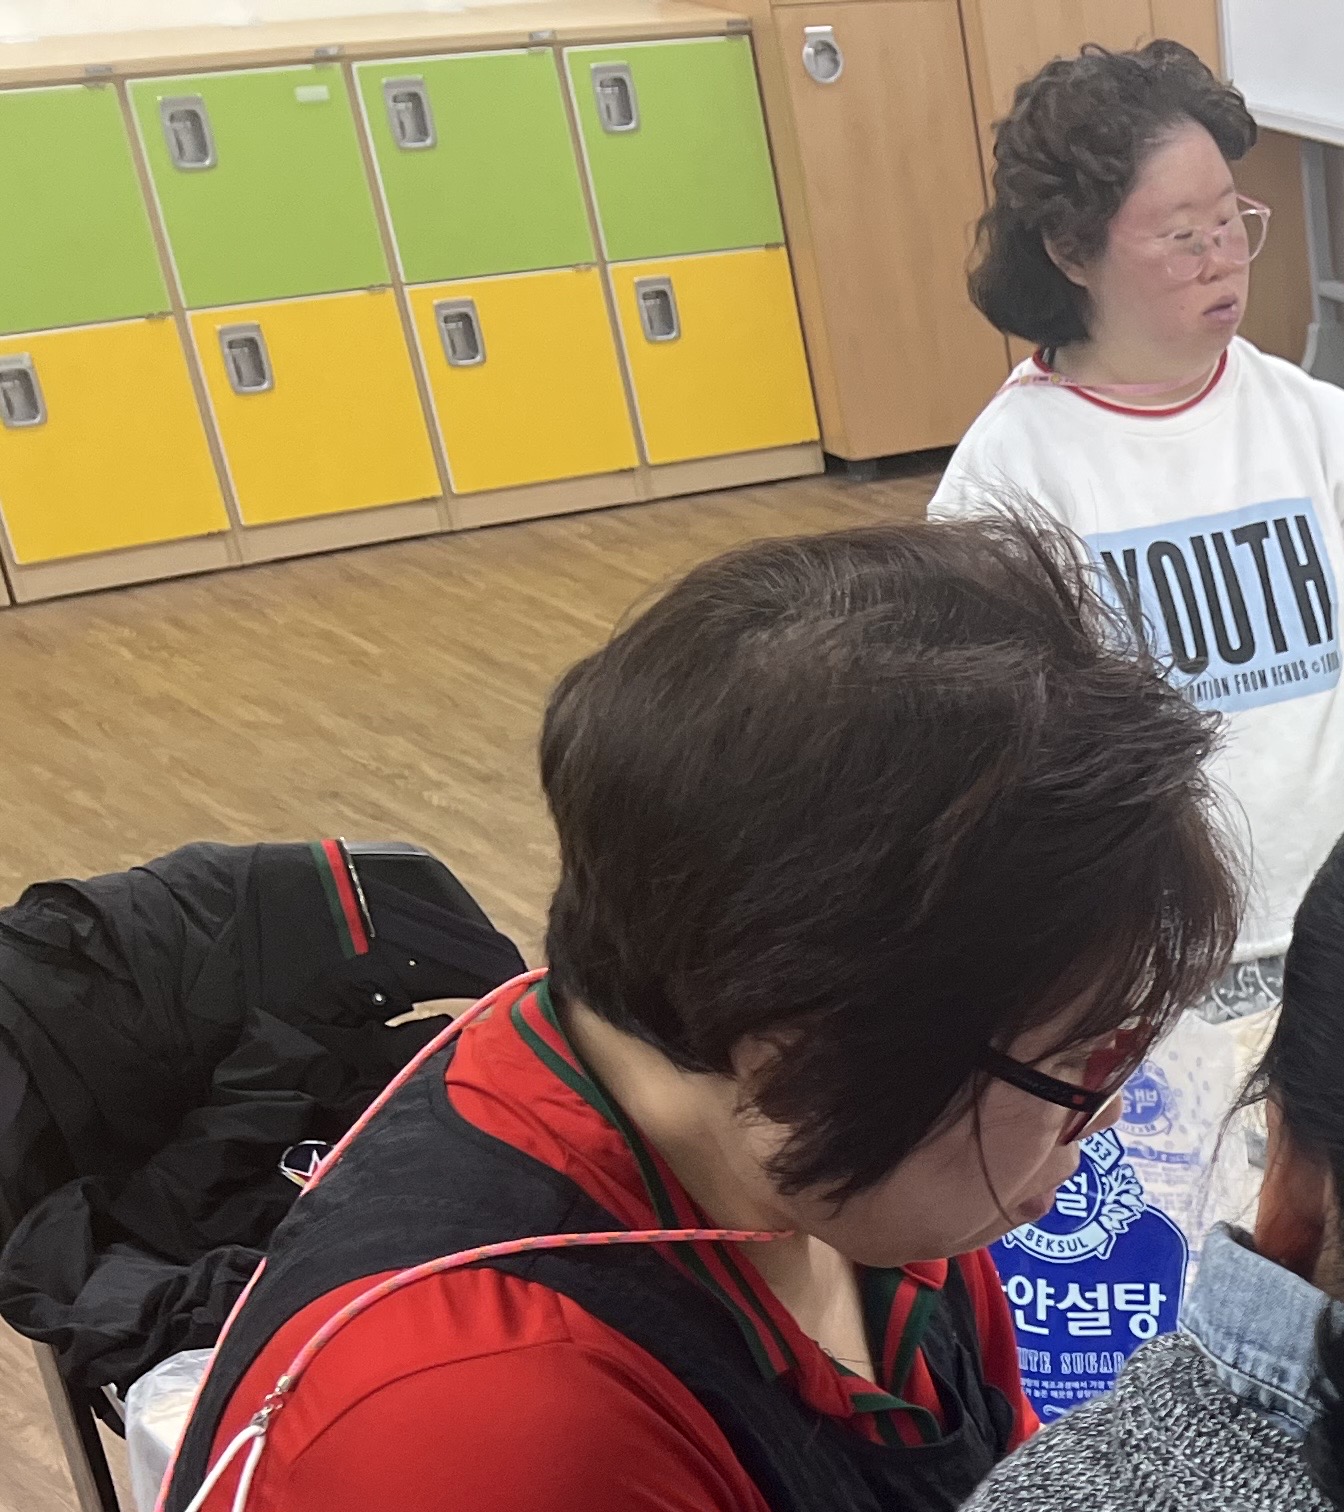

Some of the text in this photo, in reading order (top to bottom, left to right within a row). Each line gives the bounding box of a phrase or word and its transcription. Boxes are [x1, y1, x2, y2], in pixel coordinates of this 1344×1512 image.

[1100, 515, 1334, 675] YOUTH
[1234, 668, 1268, 694] FROM
[1055, 1172, 1088, 1217] 설
[1025, 1229, 1089, 1253] BEKSUL
[1001, 1274, 1167, 1340] 얀설탕
